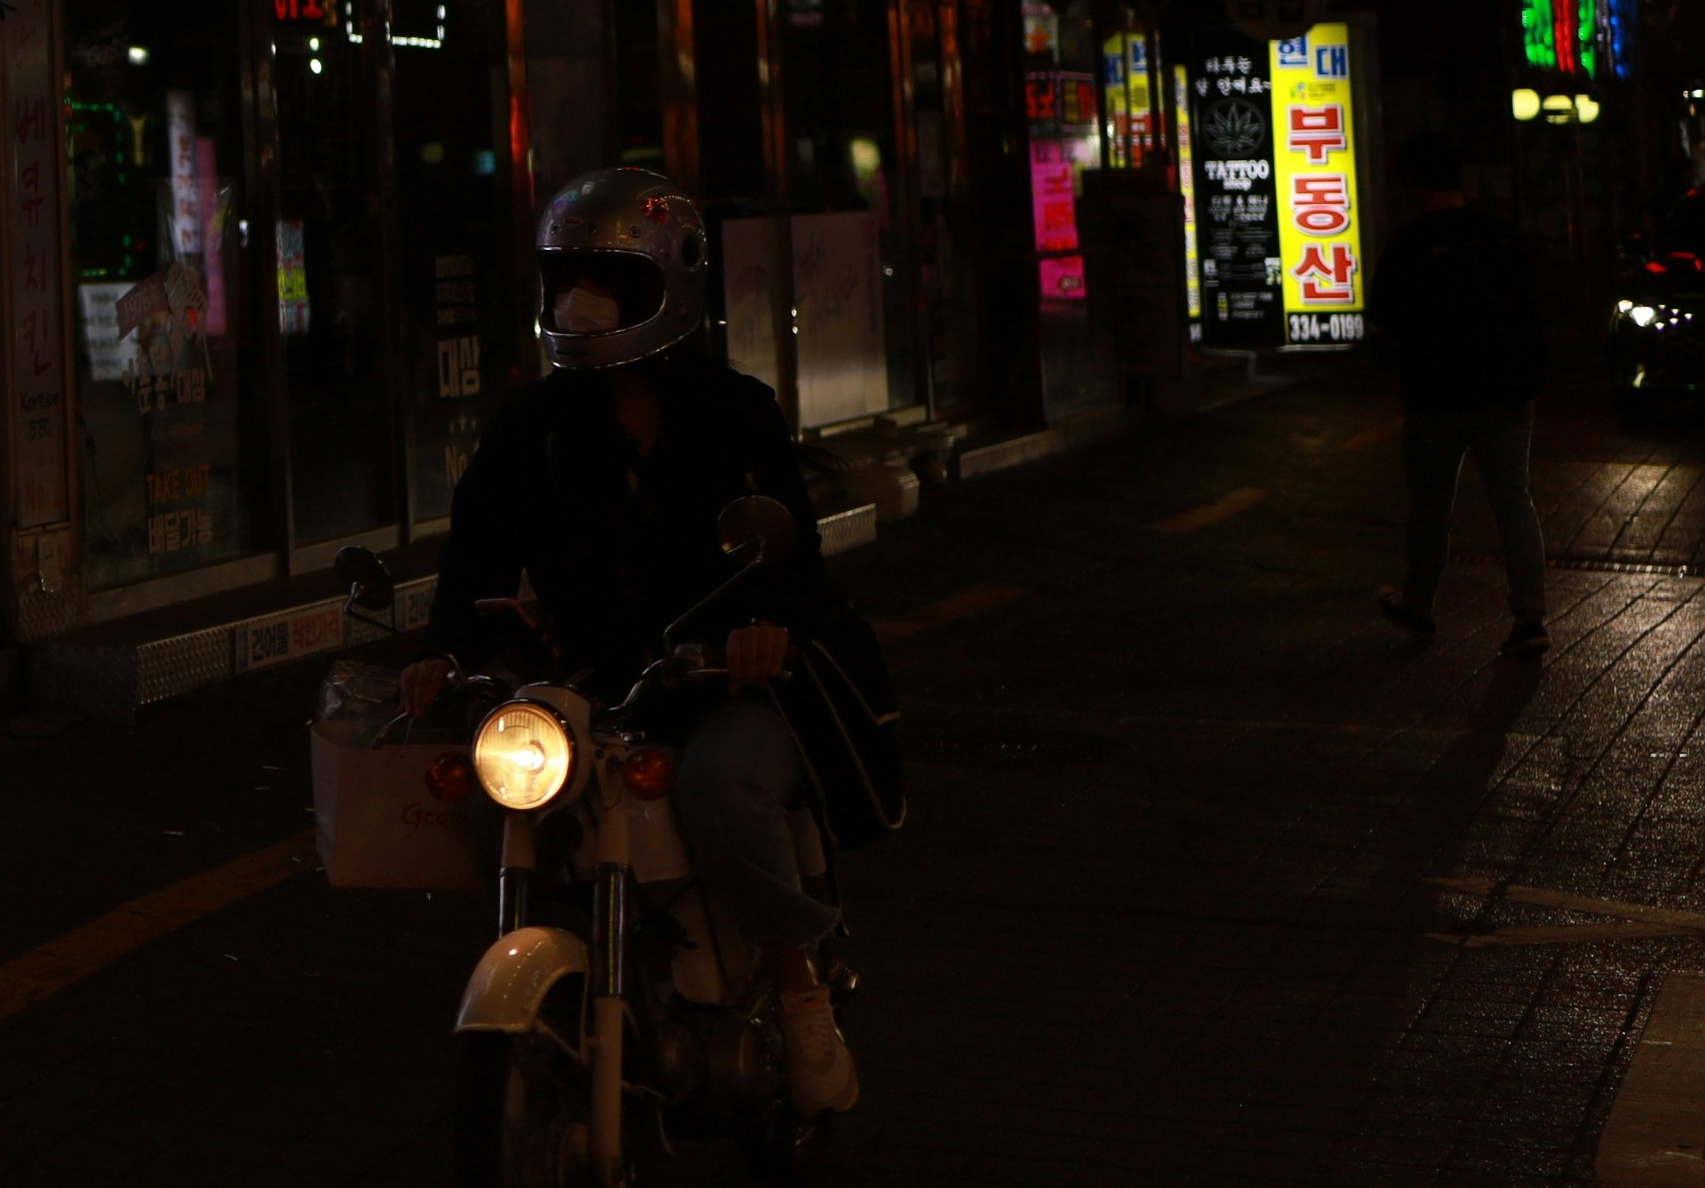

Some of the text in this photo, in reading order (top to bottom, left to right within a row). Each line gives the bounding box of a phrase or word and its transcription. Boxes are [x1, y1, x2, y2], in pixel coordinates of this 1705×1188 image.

[1204, 159, 1270, 181] TATTOO
[1289, 105, 1356, 304] 부동산
[1289, 313, 1364, 341] 334-0199
[437, 334, 481, 399] 대상
[146, 462, 213, 504] TAKE OUT
[148, 506, 213, 555] 배달가능
